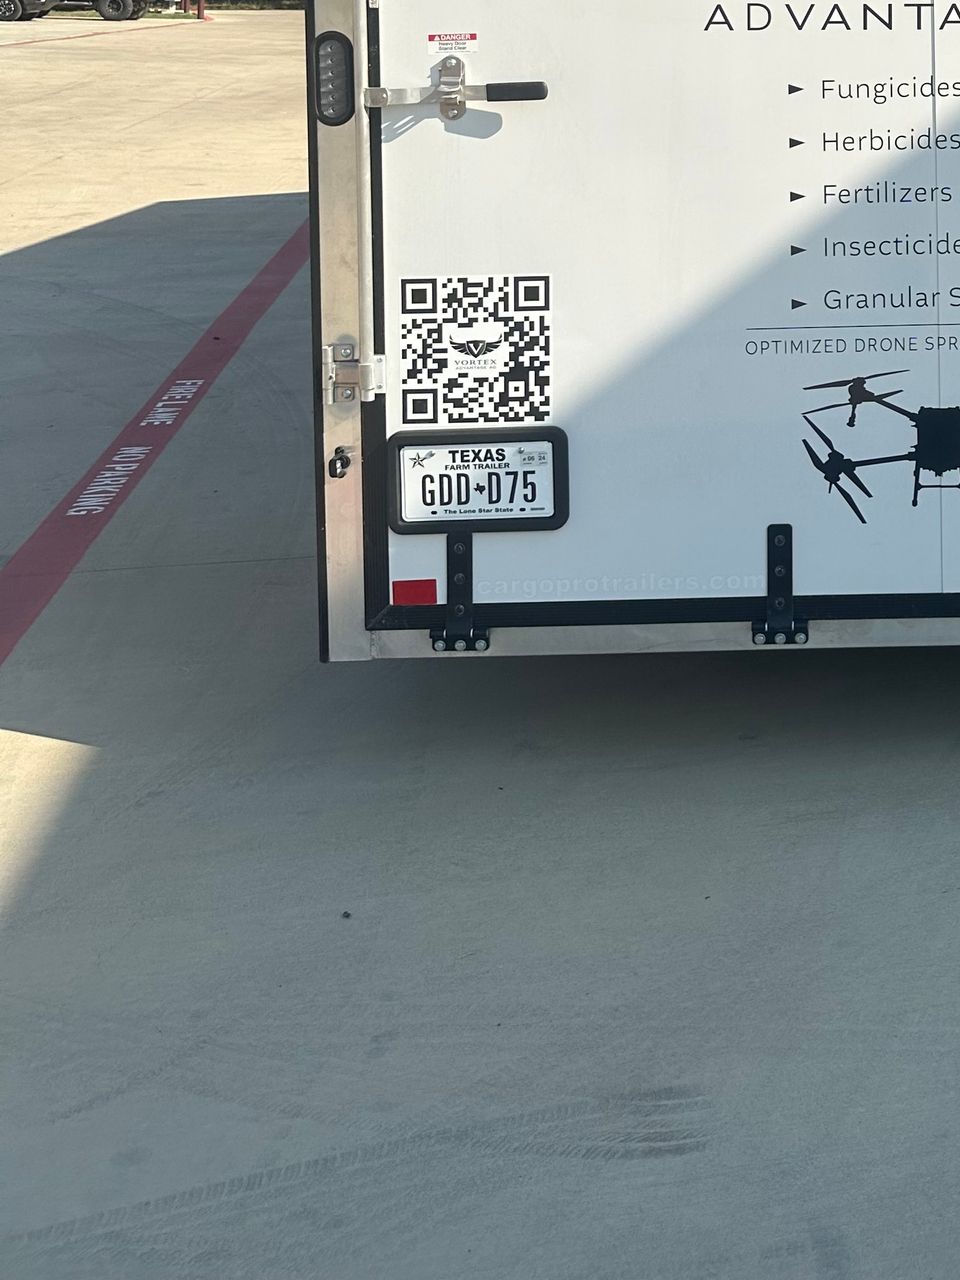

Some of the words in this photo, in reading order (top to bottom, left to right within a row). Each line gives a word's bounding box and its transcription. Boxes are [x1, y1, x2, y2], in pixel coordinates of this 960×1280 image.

[823, 181, 953, 205] Fertilizers
[823, 286, 940, 310] Granular
[745, 337, 848, 355] OPTIMIZED
[854, 336, 918, 354] DRONE
[161, 379, 205, 400] FIRE
[139, 400, 189, 426] LANE
[111, 446, 153, 461] NO
[448, 448, 506, 462] TEXAS
[473, 462, 510, 470] TRAILER
[65, 463, 141, 516] PARKING
[421, 473, 471, 506] GDD
[487, 470, 537, 505] D75
